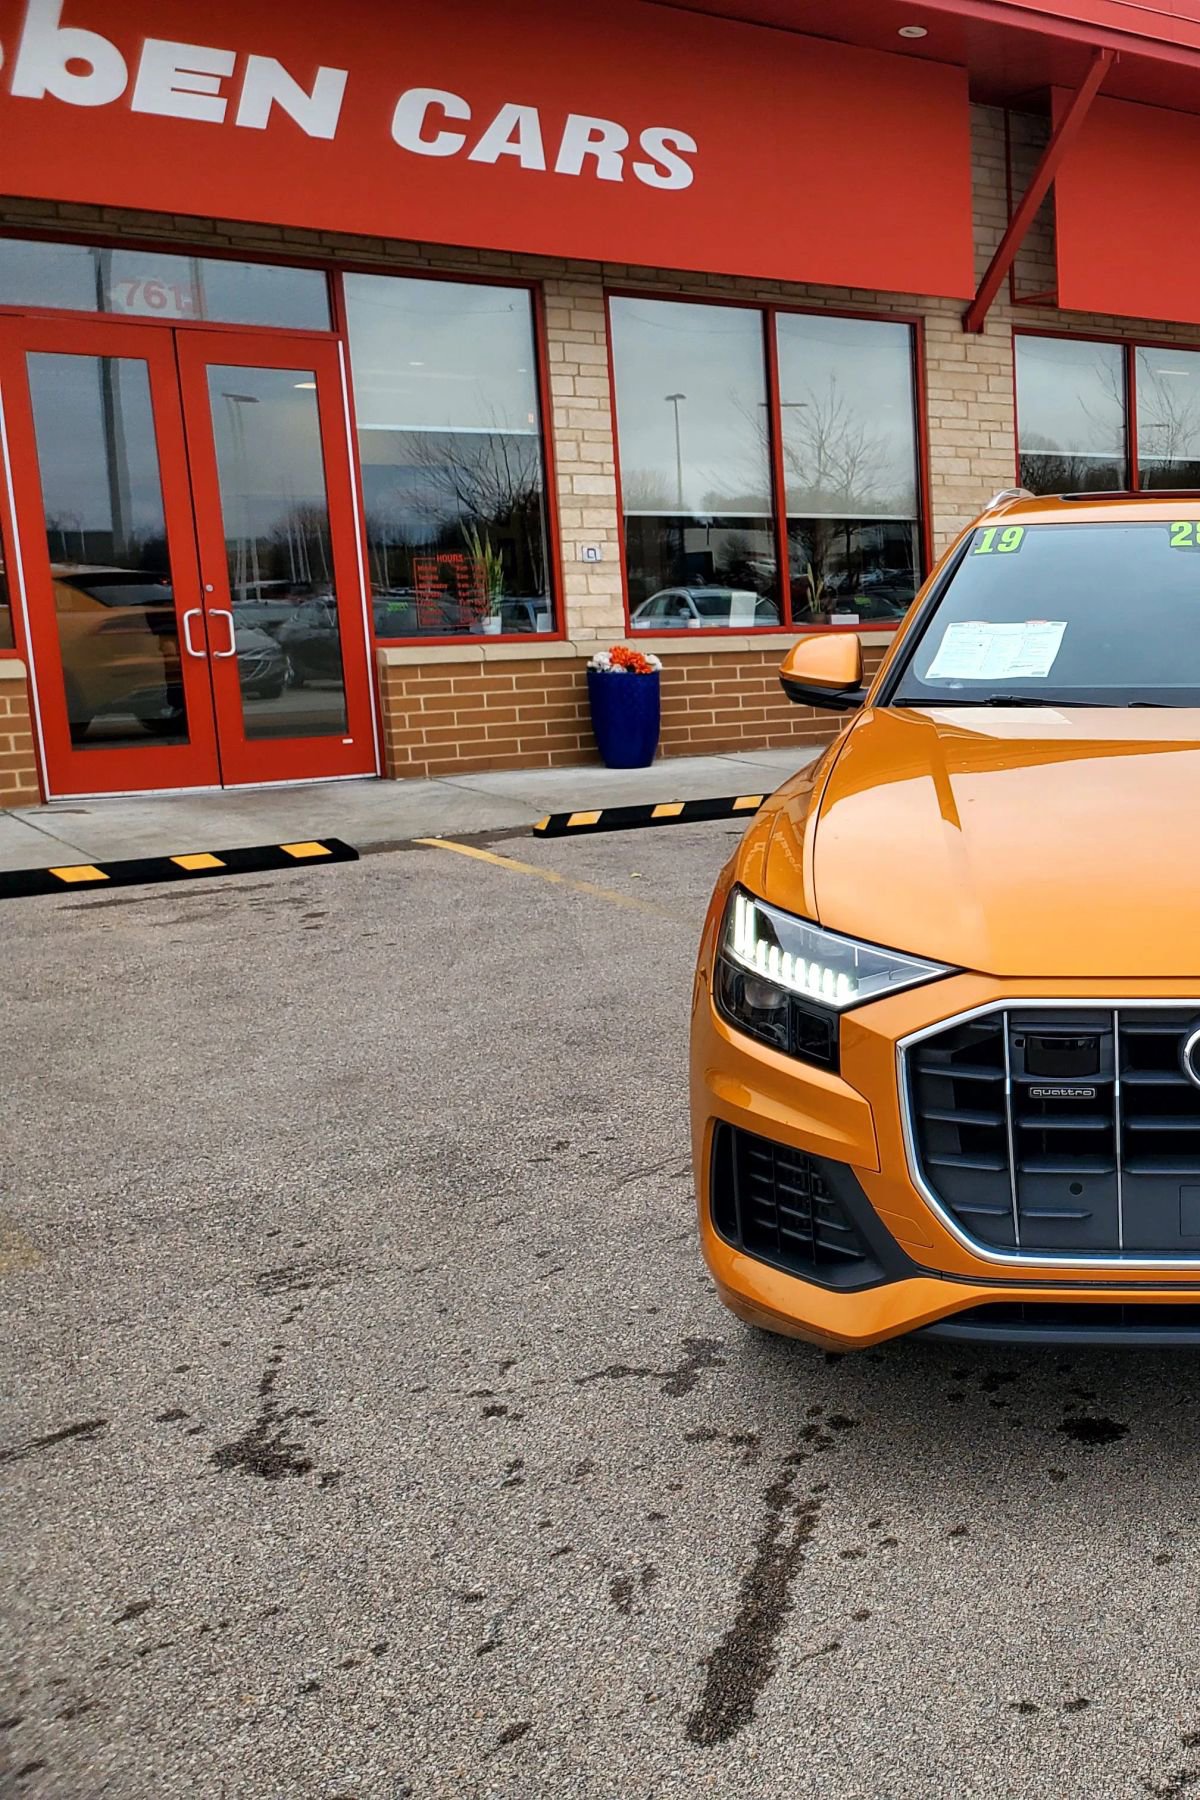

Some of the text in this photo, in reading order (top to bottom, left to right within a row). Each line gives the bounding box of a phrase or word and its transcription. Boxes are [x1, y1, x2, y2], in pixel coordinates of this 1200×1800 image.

[0, 0, 698, 190] bEN CARS
[974, 526, 1025, 554] 19
[436, 554, 464, 563] HOURS
